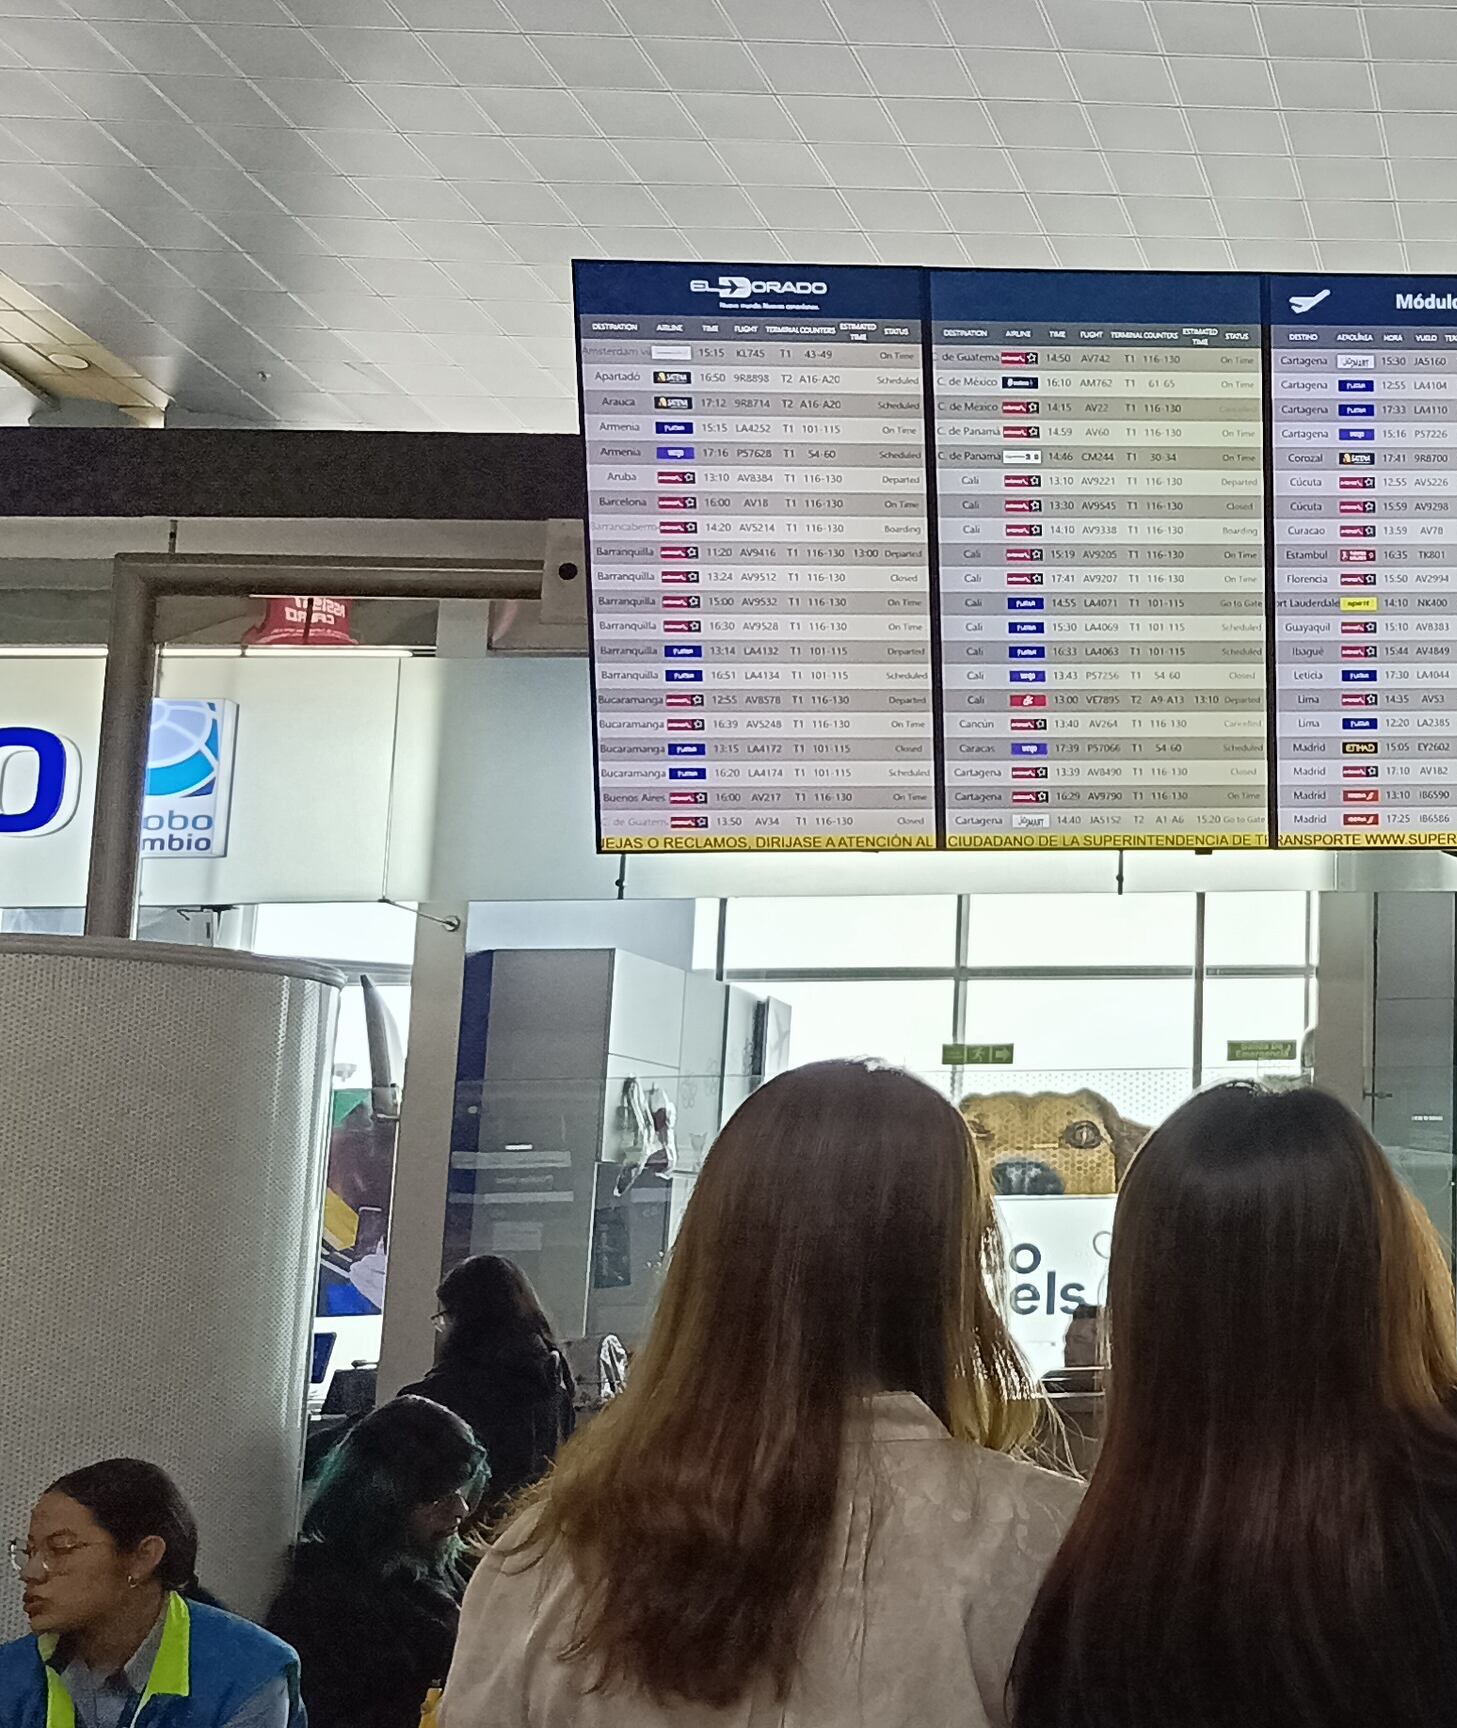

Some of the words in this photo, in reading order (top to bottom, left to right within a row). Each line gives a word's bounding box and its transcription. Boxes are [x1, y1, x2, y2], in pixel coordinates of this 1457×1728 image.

[1281, 356, 1327, 367] Cartagena
[1382, 357, 1406, 365] 15:30
[701, 373, 725, 382] 16:50
[781, 375, 792, 383] T2
[599, 497, 647, 506] Barcelona
[705, 498, 730, 507] 16:00
[786, 499, 796, 507] T1
[806, 499, 843, 508] 116-130
[963, 550, 981, 558] Cali
[1051, 550, 1075, 558] 15:19
[1129, 550, 1138, 558] T1
[1148, 551, 1184, 559] 116-130
[1287, 551, 1327, 559] Estambul
[1384, 551, 1407, 559] 16:35
[968, 696, 984, 704] Cali
[1131, 696, 1141, 704] T2
[601, 745, 665, 755] Bucaramanga
[714, 744, 739, 753] 13:15
[795, 744, 804, 752] T1
[1293, 743, 1325, 751] Madrid
[1387, 743, 1409, 751] 15:05
[648, 838, 658, 848] O
[664, 837, 751, 849] RECLAMOS,
[756, 837, 821, 847] DIRIJASE
[838, 835, 912, 847] ATENCIÓN
[916, 837, 932, 847] AL
[948, 835, 1035, 846] CIUDADANO
[1039, 835, 1058, 846] DE
[1063, 836, 1080, 846] LA
[1084, 835, 1228, 845] SUPERINTENDENCIA
[1233, 835, 1250, 845] DE
[1255, 836, 1268, 845] T
